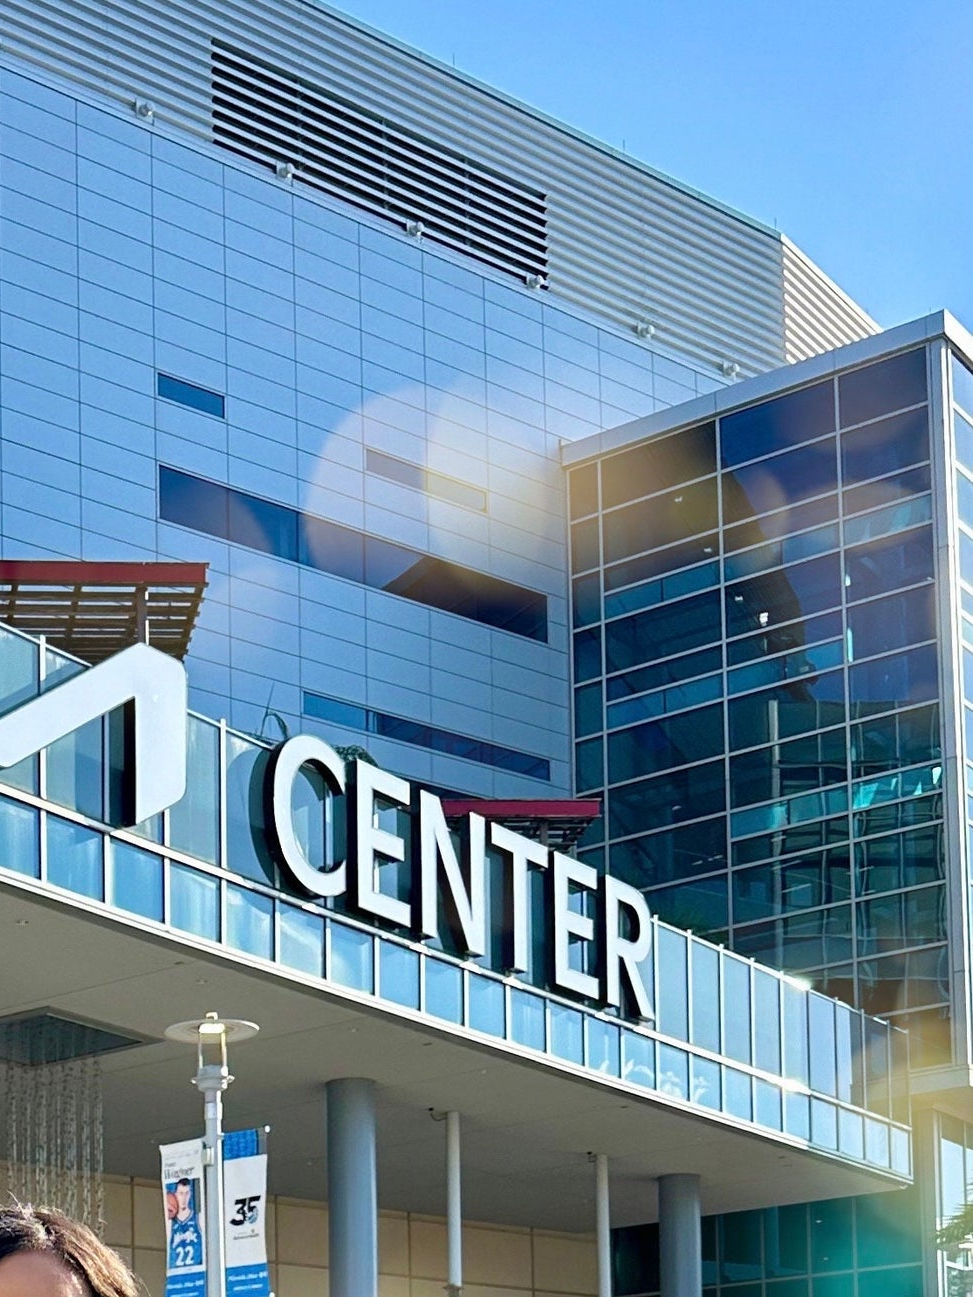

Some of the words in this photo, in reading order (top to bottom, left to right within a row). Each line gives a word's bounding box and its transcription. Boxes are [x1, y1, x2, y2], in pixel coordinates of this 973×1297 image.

[273, 733, 656, 1022] CENTER
[230, 1195, 261, 1226] 35
[175, 1246, 195, 1266] 22
